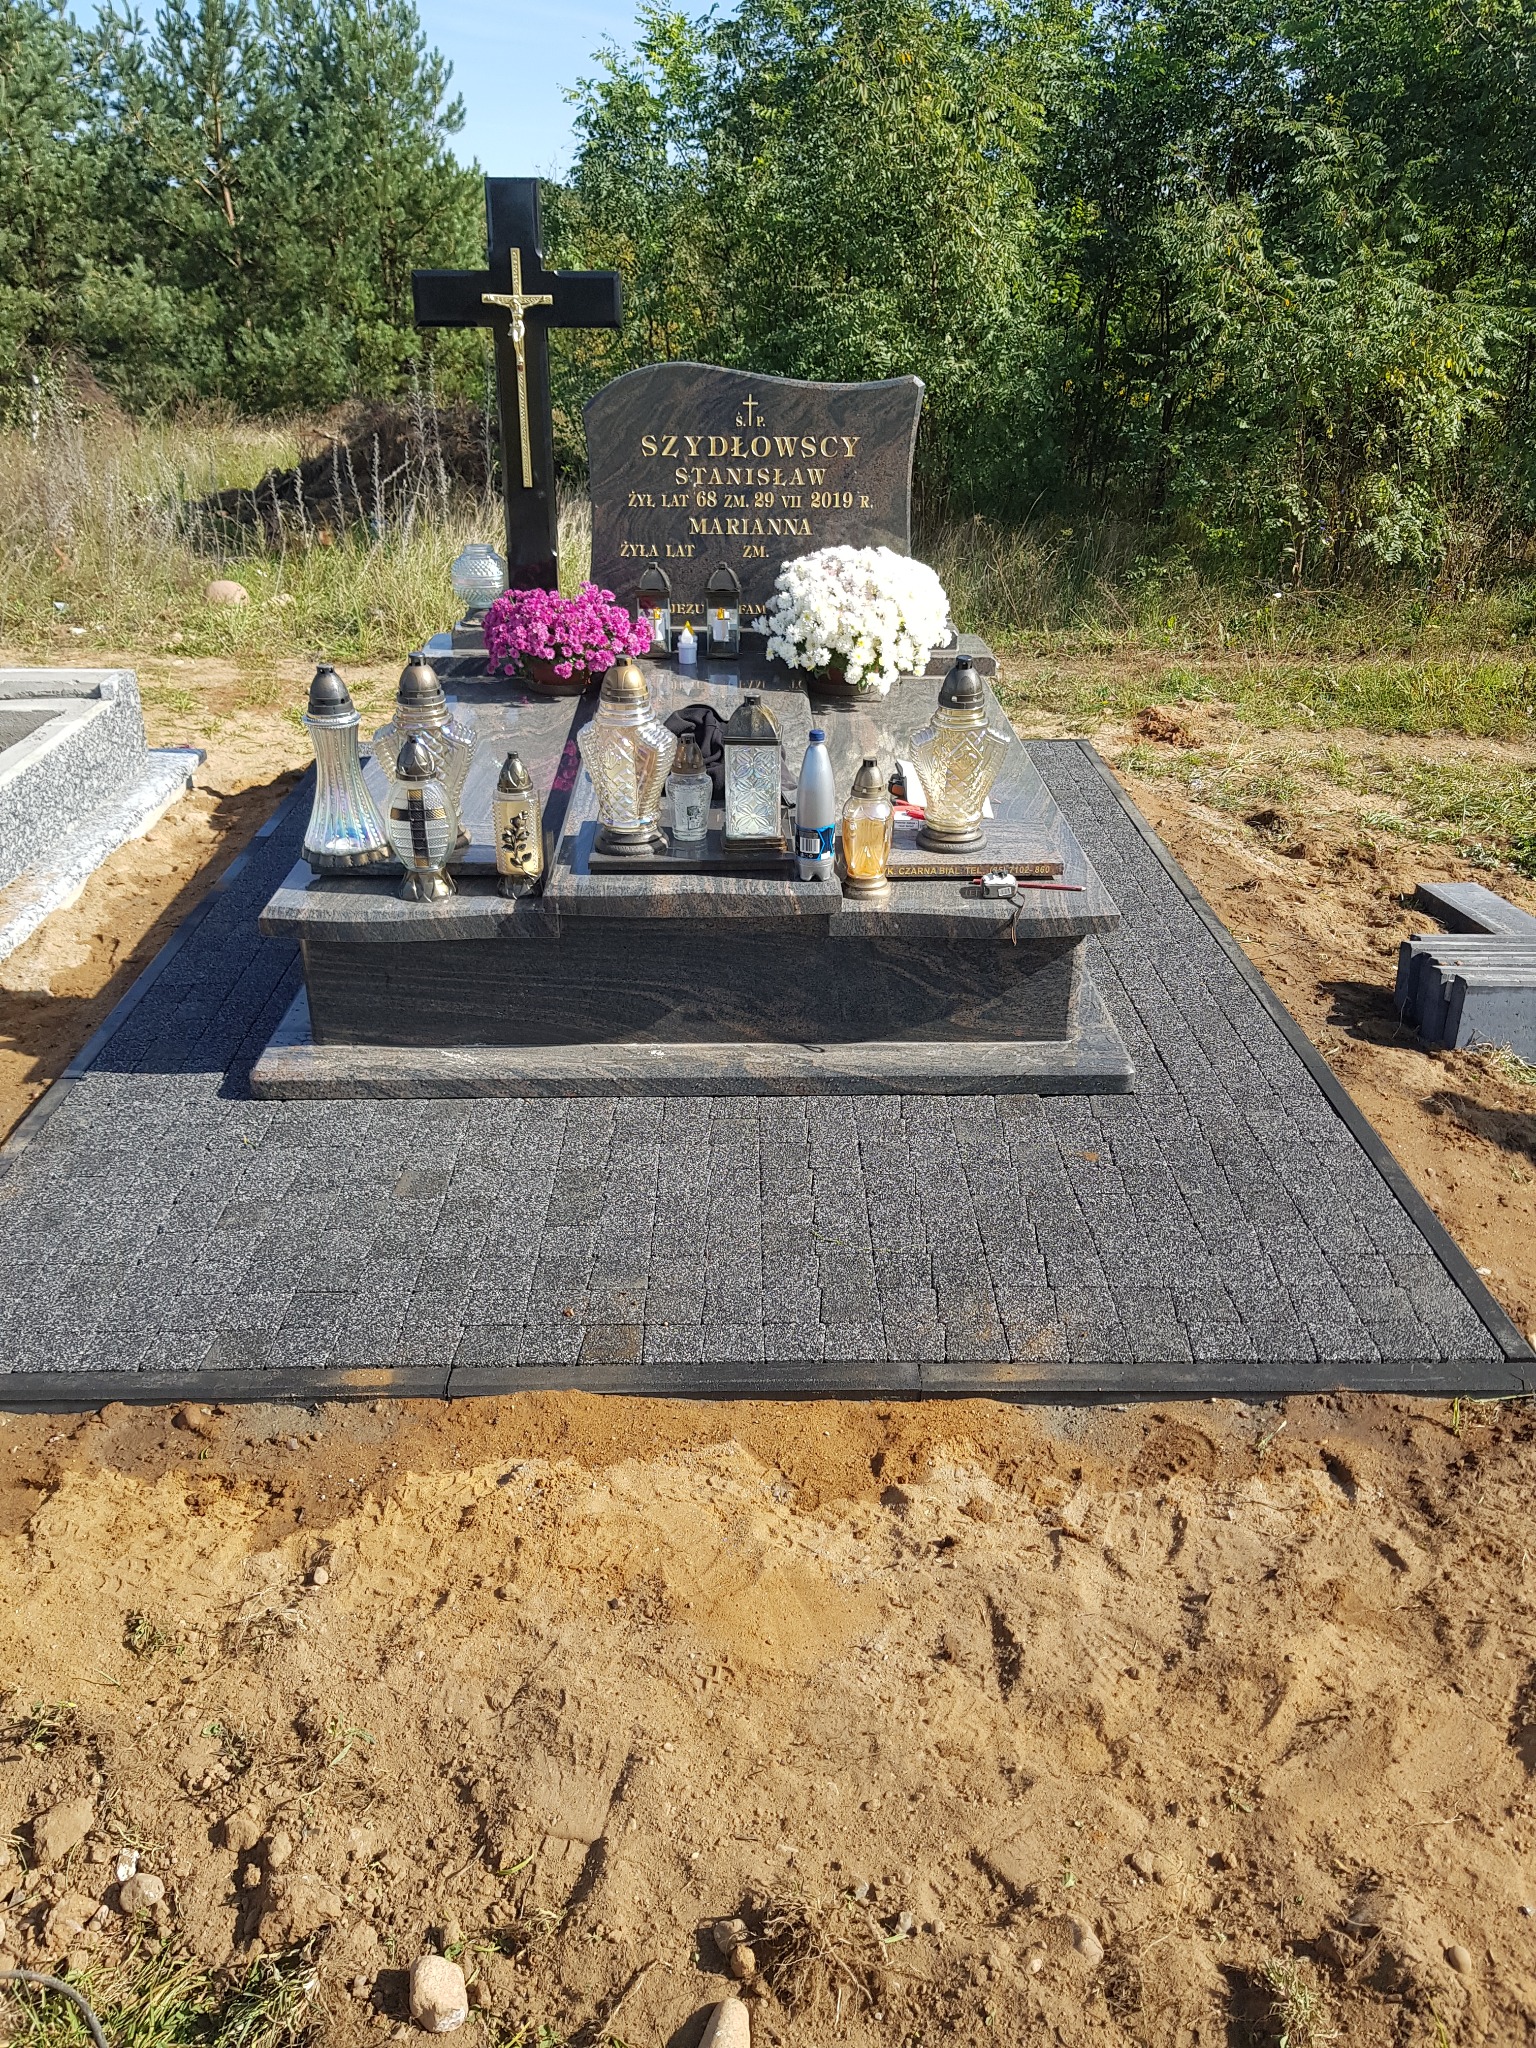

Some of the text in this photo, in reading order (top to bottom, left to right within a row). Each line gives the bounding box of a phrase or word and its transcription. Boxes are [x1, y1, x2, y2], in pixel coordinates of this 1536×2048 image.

[756, 415, 766, 427] P.
[641, 435, 861, 458] SZYDŁOWSCY
[675, 467, 827, 486] STANISŁAW
[628, 490, 873, 509] ŻYŁ LAT 68 ZM. 29 VII 2019 R.
[688, 517, 813, 536] MARIANNA
[620, 540, 769, 559] ŻYŁA LAT ZM.
[898, 866, 937, 875] CZARNA
[965, 866, 985, 875] TEL.
